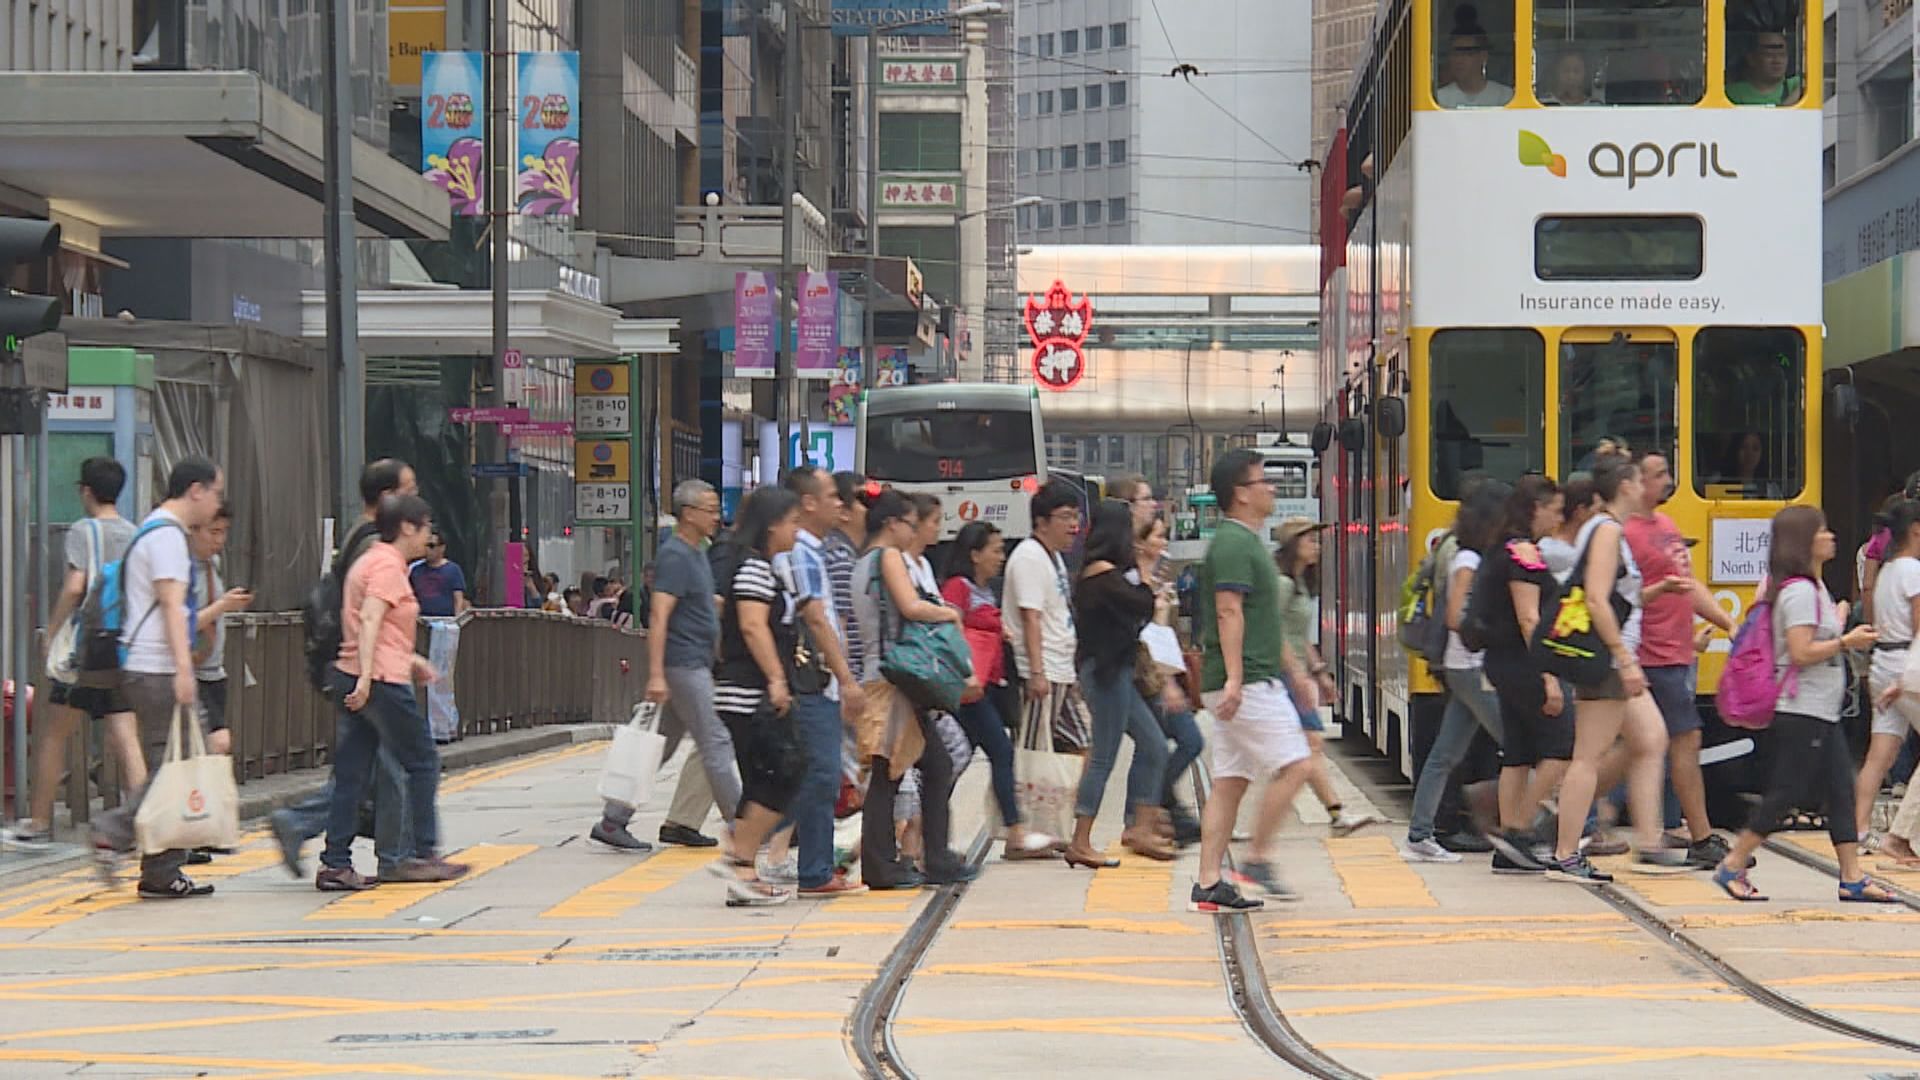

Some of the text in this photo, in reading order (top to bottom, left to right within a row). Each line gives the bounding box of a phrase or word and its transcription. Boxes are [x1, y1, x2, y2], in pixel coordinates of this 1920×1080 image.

[1588, 141, 1738, 190] april
[1520, 293, 1726, 314] Insurance made easy.
[596, 400, 626, 411] 8-10
[597, 416, 621, 428] 5-7
[937, 458, 964, 478] 914
[597, 488, 626, 499] 8-10
[596, 504, 619, 515] 4-7
[1721, 560, 1755, 575] North
